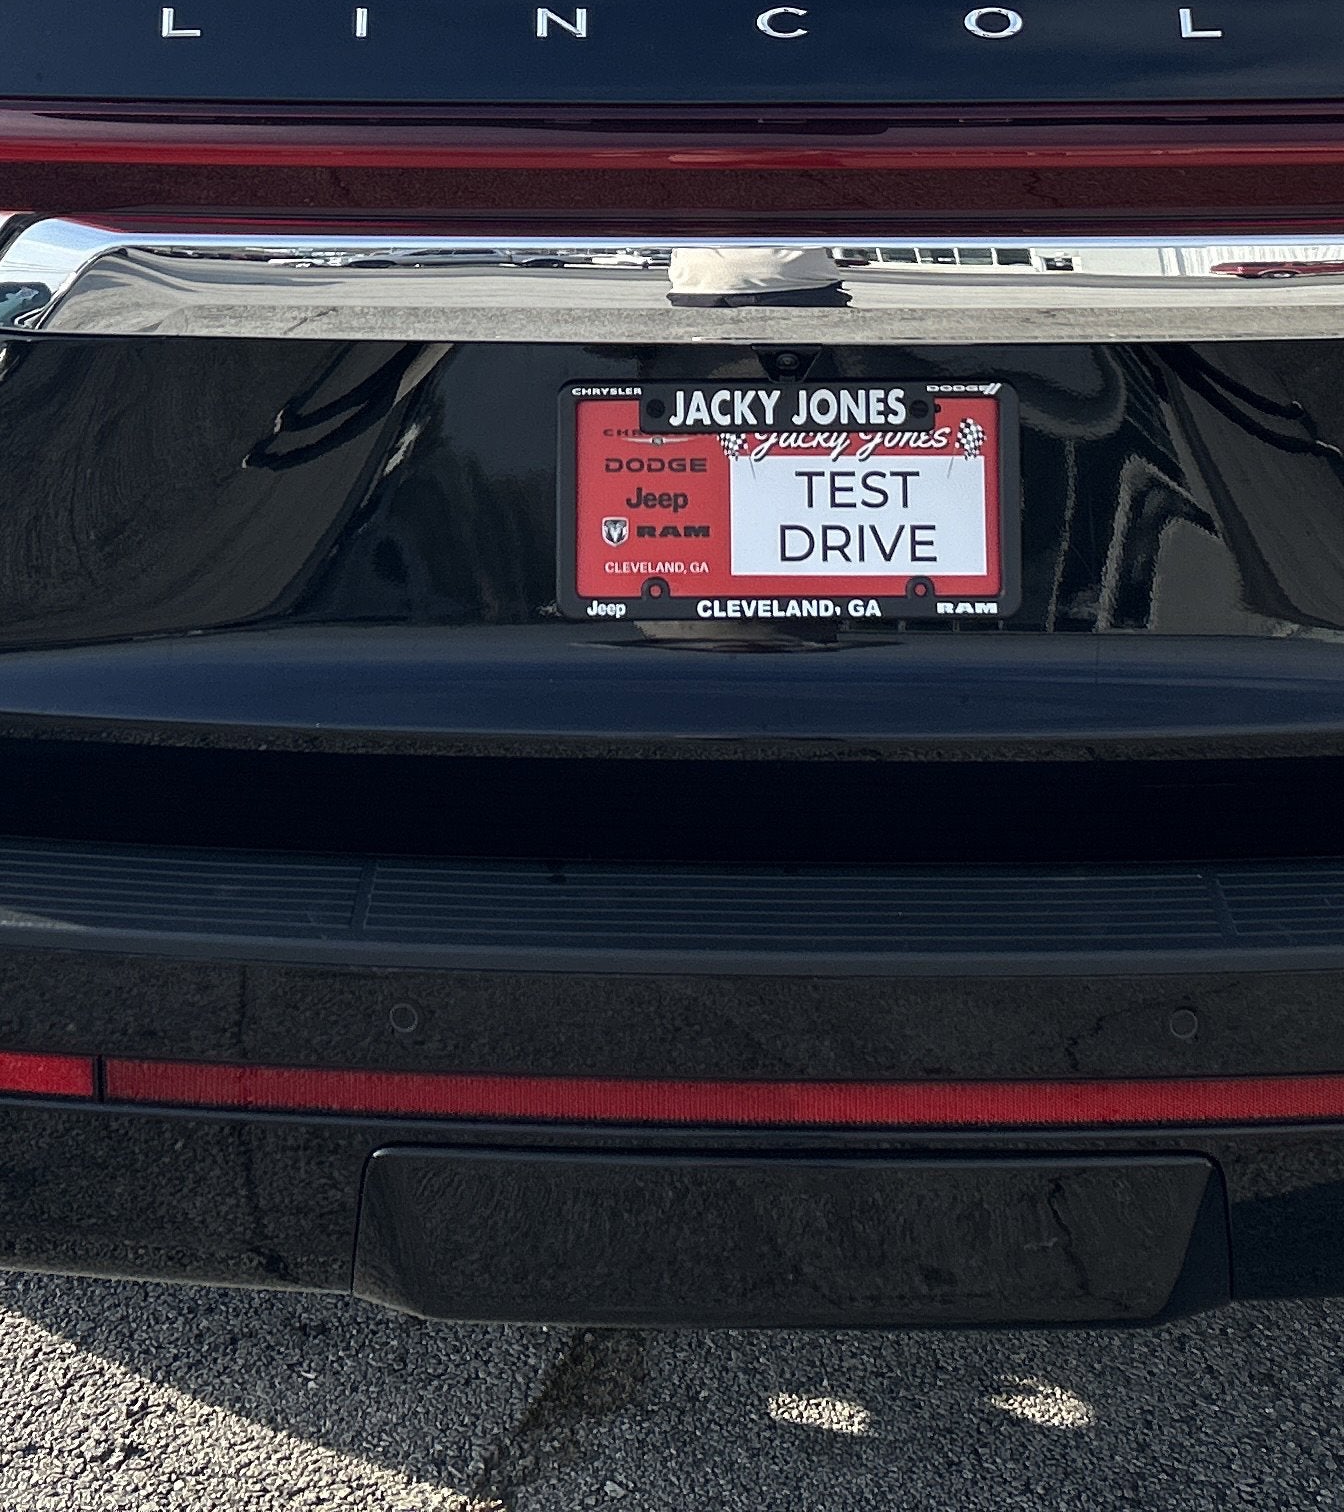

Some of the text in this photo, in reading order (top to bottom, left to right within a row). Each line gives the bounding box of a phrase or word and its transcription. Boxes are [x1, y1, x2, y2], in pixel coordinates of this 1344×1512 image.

[572, 387, 642, 396] CHRYSLER
[668, 389, 906, 426] JACKY JONES
[604, 457, 707, 473] DODGE
[795, 470, 921, 509] TEST
[626, 487, 689, 513] Jeep
[636, 524, 710, 538] RAM
[780, 524, 938, 563] DRIVE
[604, 561, 709, 576] CLEVELAND, GA
[587, 600, 626, 619] Jeep
[697, 599, 882, 618] CLEVELAND, GA
[936, 601, 998, 614] RAM
